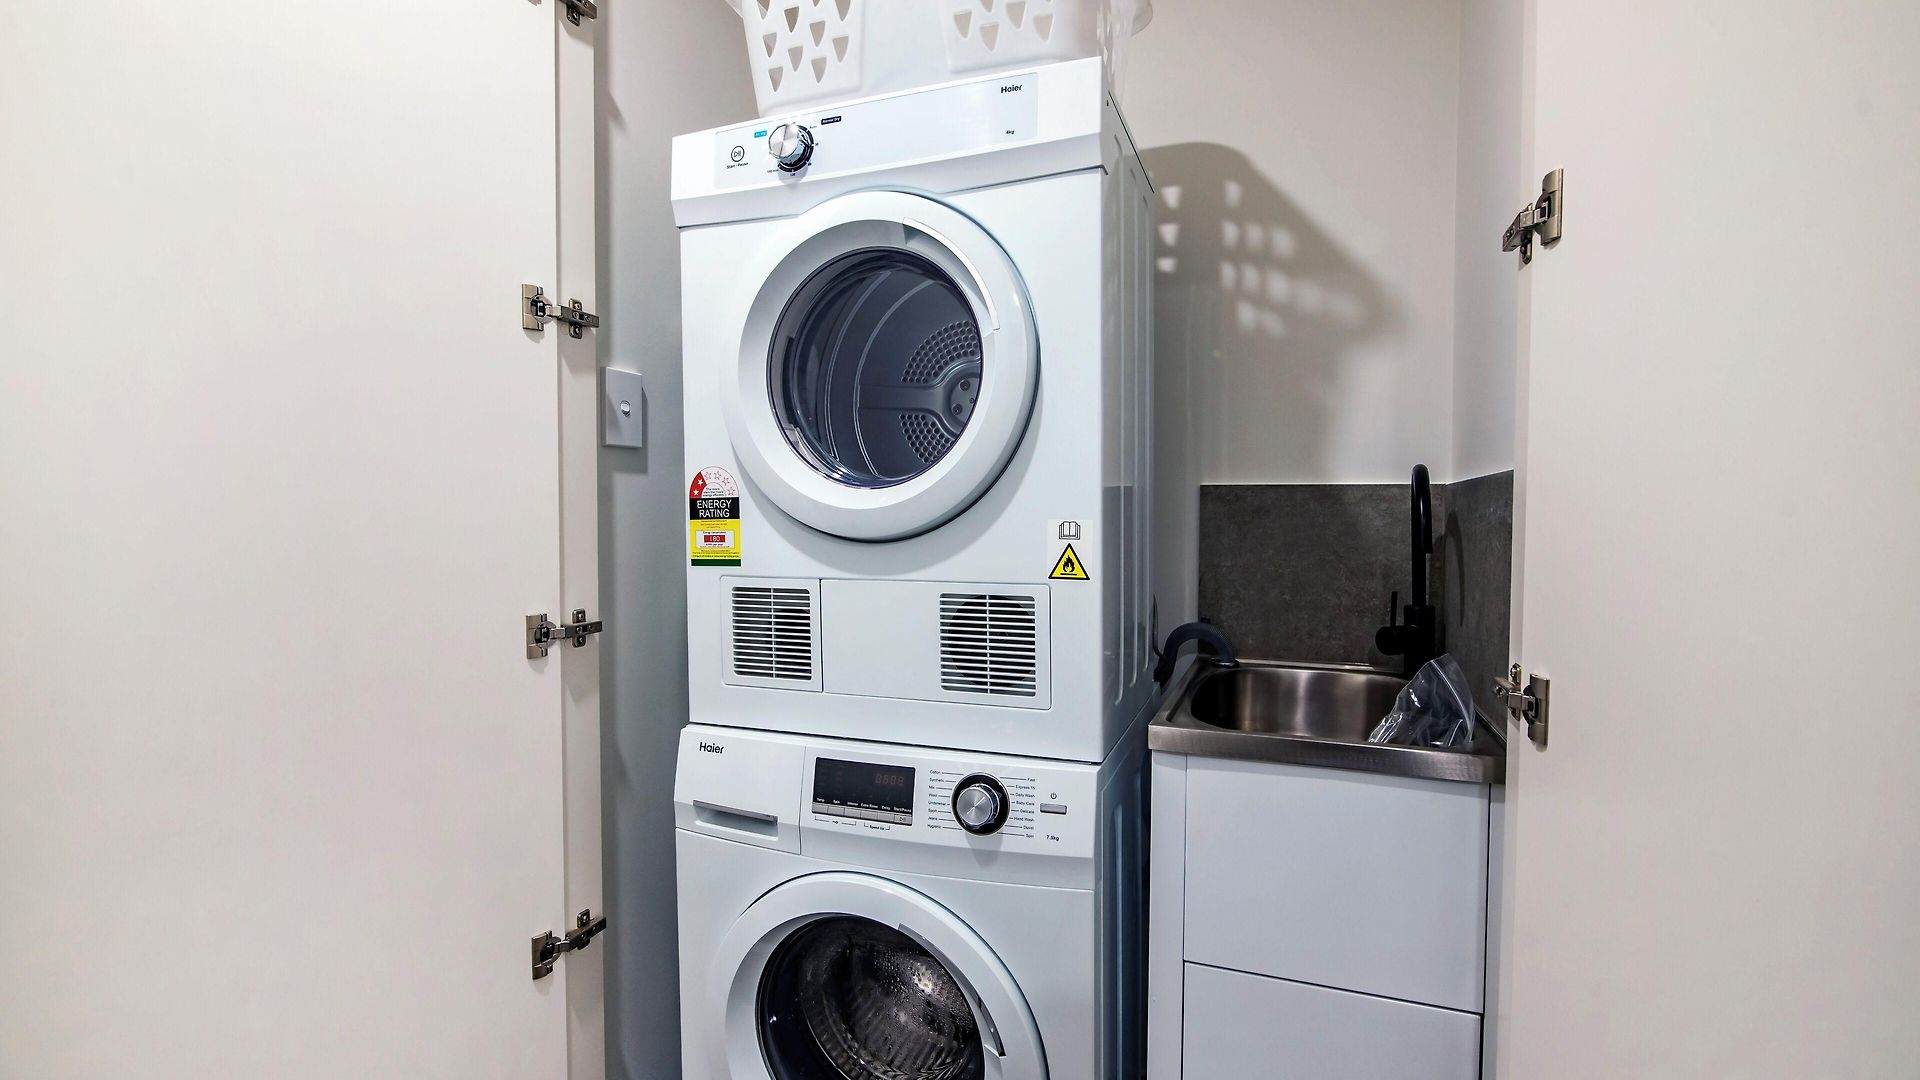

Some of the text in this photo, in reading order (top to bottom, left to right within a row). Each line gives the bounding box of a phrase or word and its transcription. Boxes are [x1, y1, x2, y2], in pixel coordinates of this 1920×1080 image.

[1001, 85, 1022, 93] Haier
[697, 499, 732, 508] ENERGY
[699, 509, 730, 518] RATING
[699, 742, 724, 754] Haier
